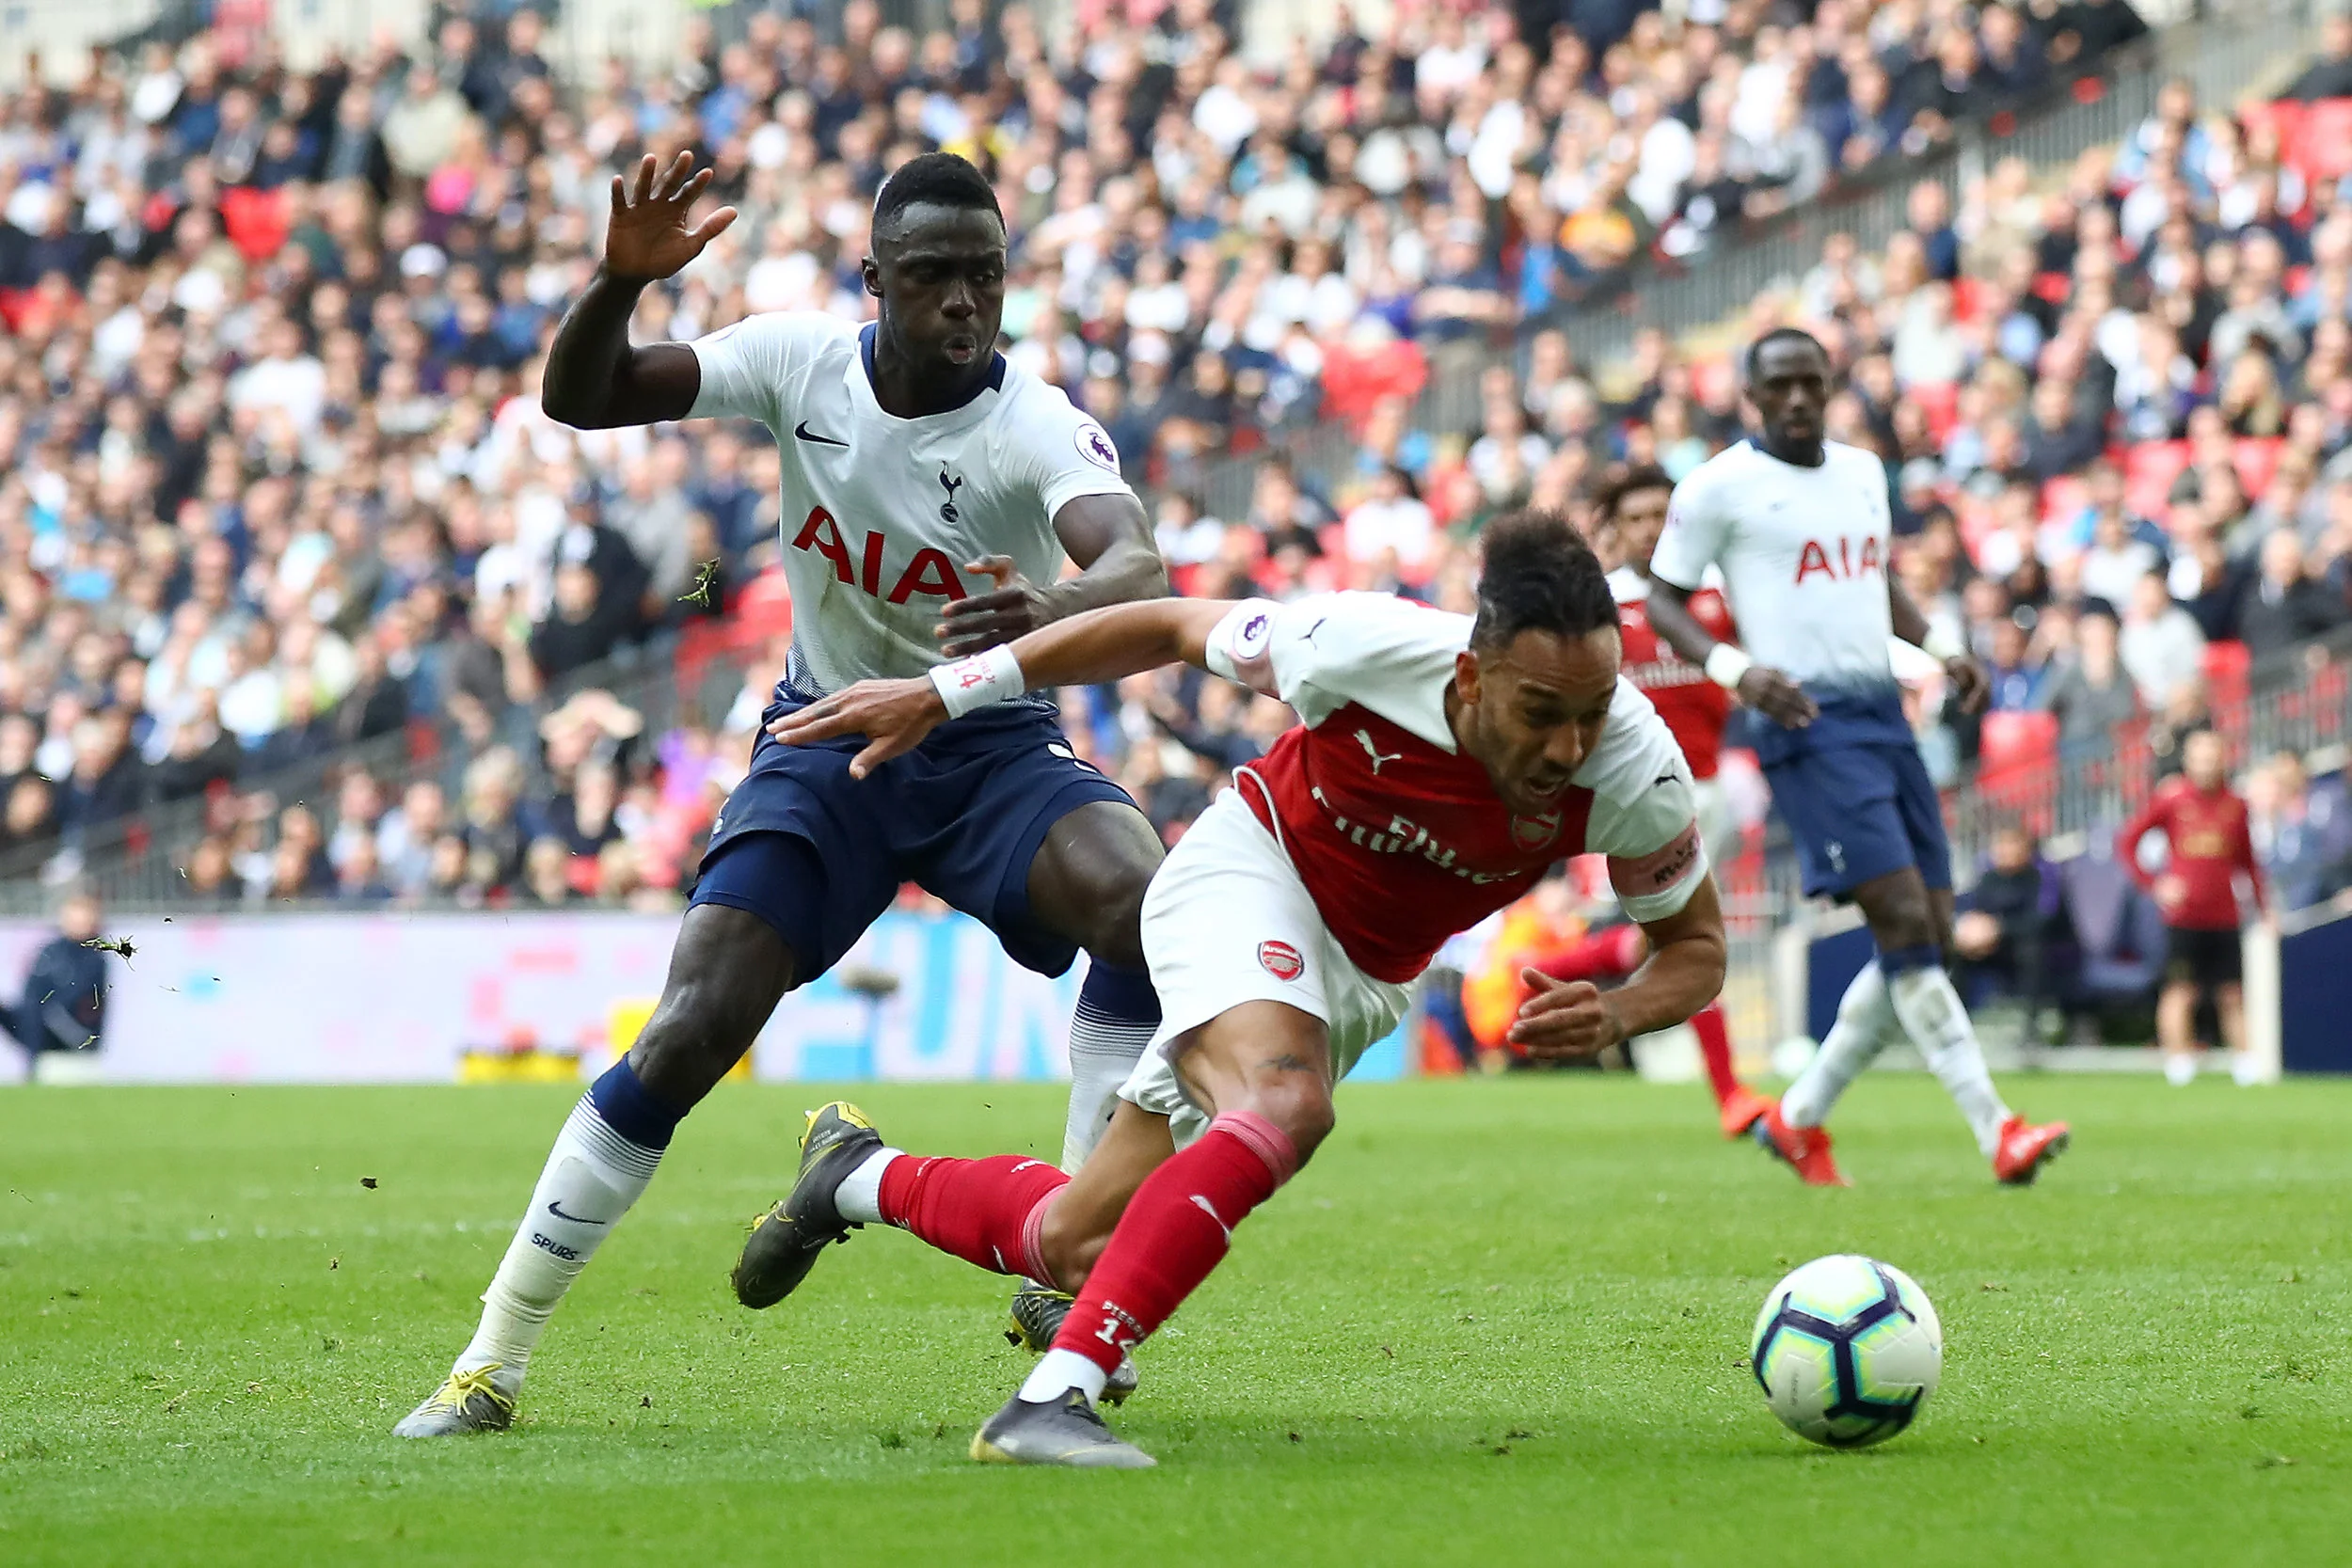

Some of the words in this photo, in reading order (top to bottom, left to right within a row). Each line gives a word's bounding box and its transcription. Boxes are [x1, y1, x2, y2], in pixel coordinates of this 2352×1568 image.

[791, 505, 967, 605] AIA
[1796, 536, 1881, 586] AIA
[532, 1233, 580, 1260] SPURS
